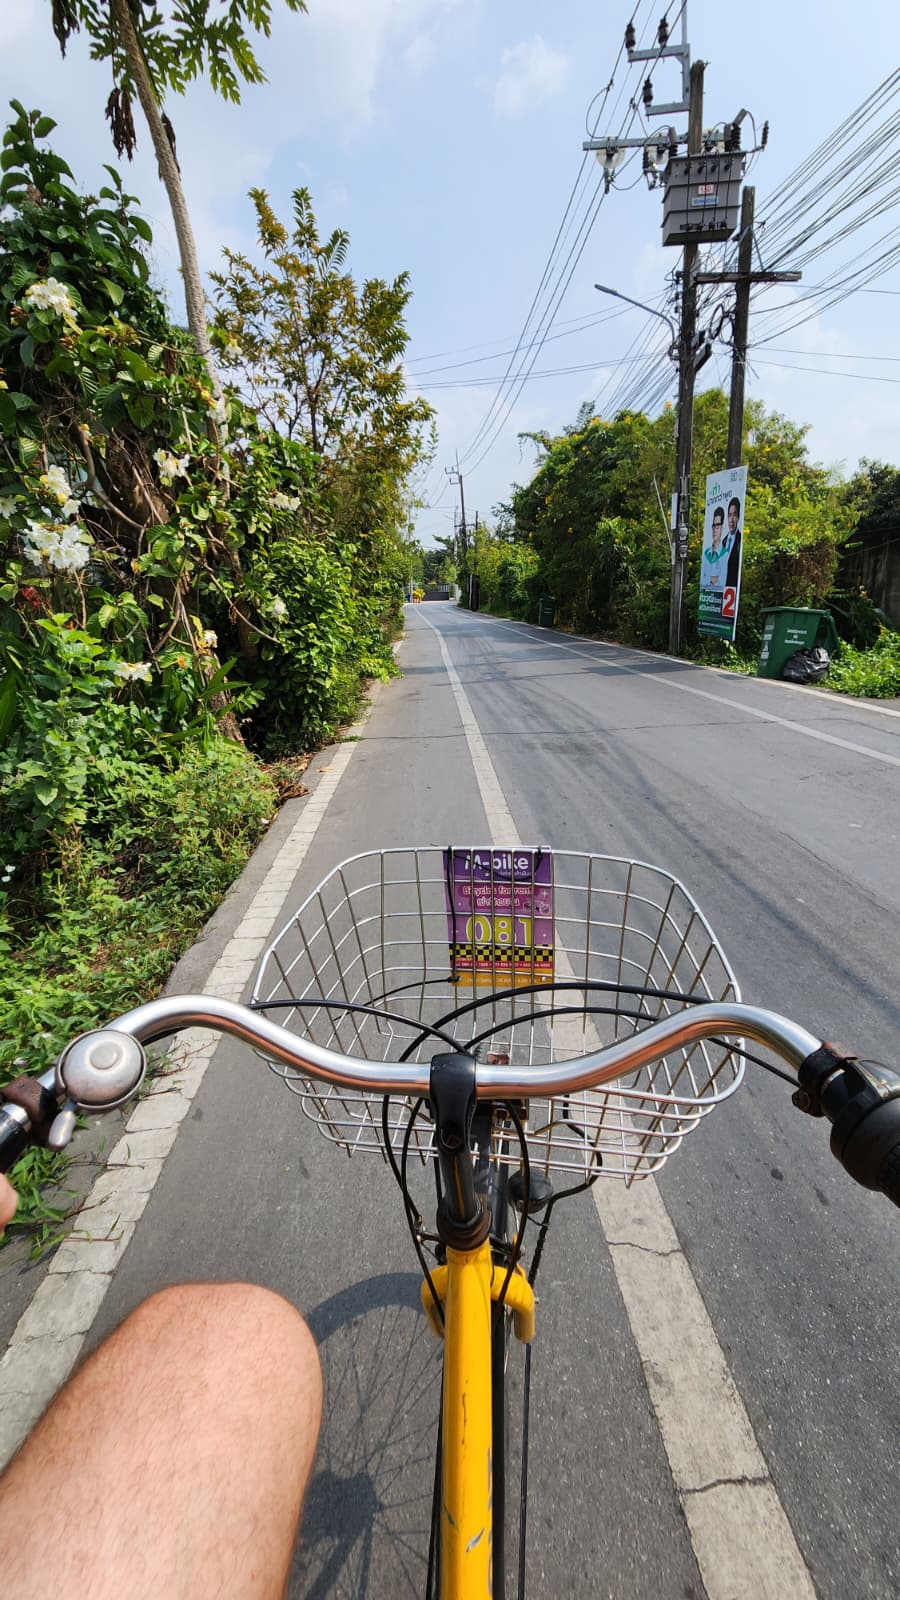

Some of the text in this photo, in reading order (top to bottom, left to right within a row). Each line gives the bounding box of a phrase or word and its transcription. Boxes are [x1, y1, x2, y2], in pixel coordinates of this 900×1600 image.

[723, 587, 735, 616] 2
[465, 853, 529, 870] M-bike
[465, 915, 532, 948] 081
